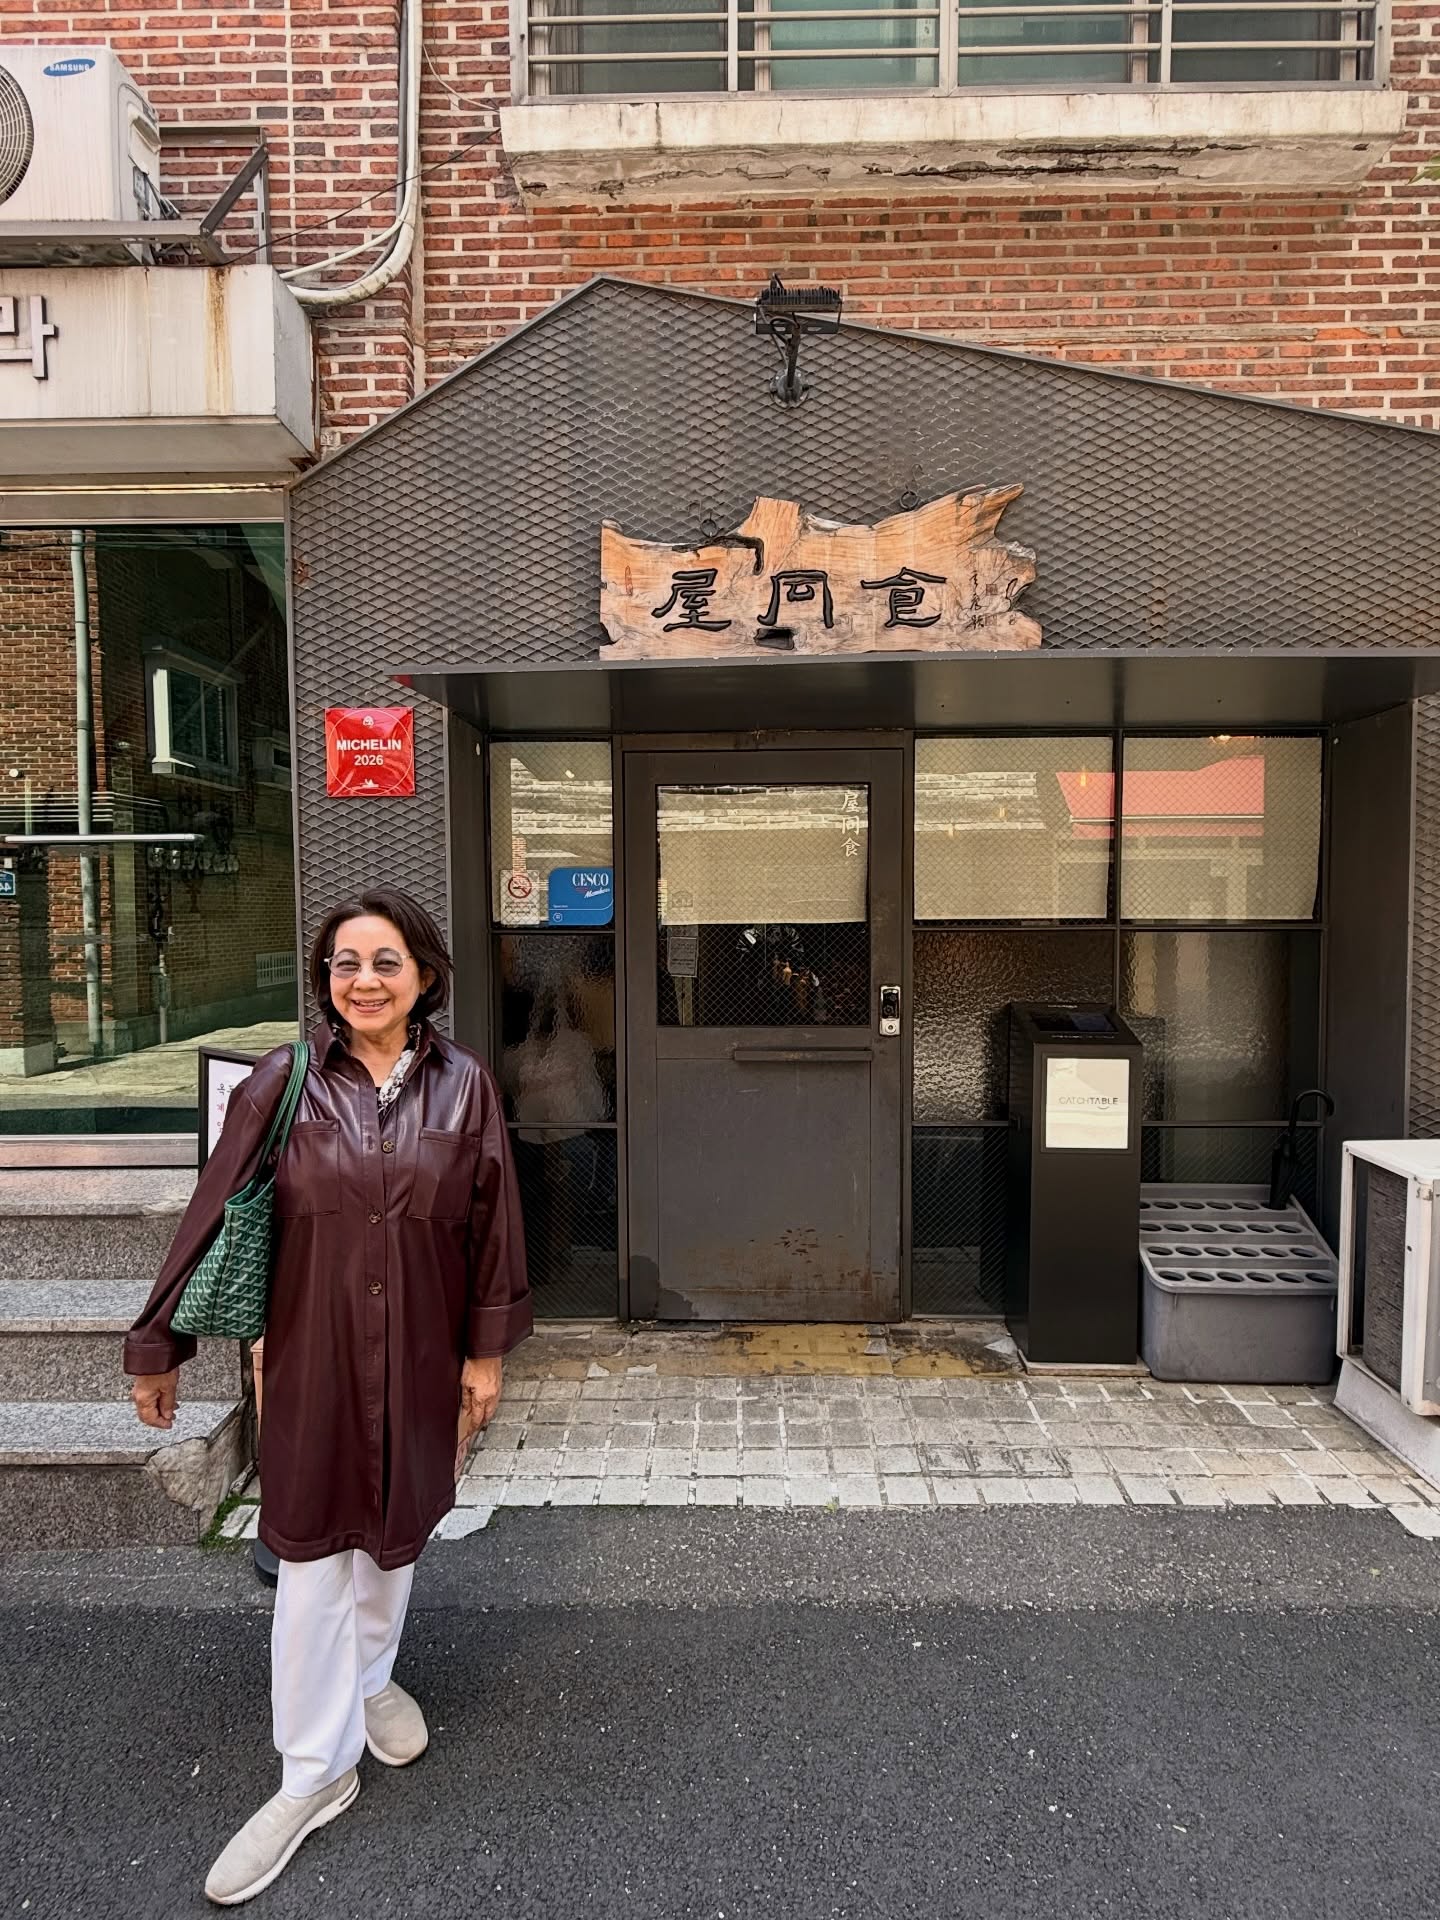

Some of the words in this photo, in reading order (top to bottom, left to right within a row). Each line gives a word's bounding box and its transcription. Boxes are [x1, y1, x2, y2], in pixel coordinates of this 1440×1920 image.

[49, 63, 90, 72] SAMSUNG
[652, 567, 947, 632] 屋同食
[336, 739, 402, 751] MICHELIN
[354, 754, 384, 766] 2026
[841, 789, 861, 857] 屋同食
[572, 872, 609, 887] CESCO
[1058, 1097, 1119, 1105] CATCHTABLE
